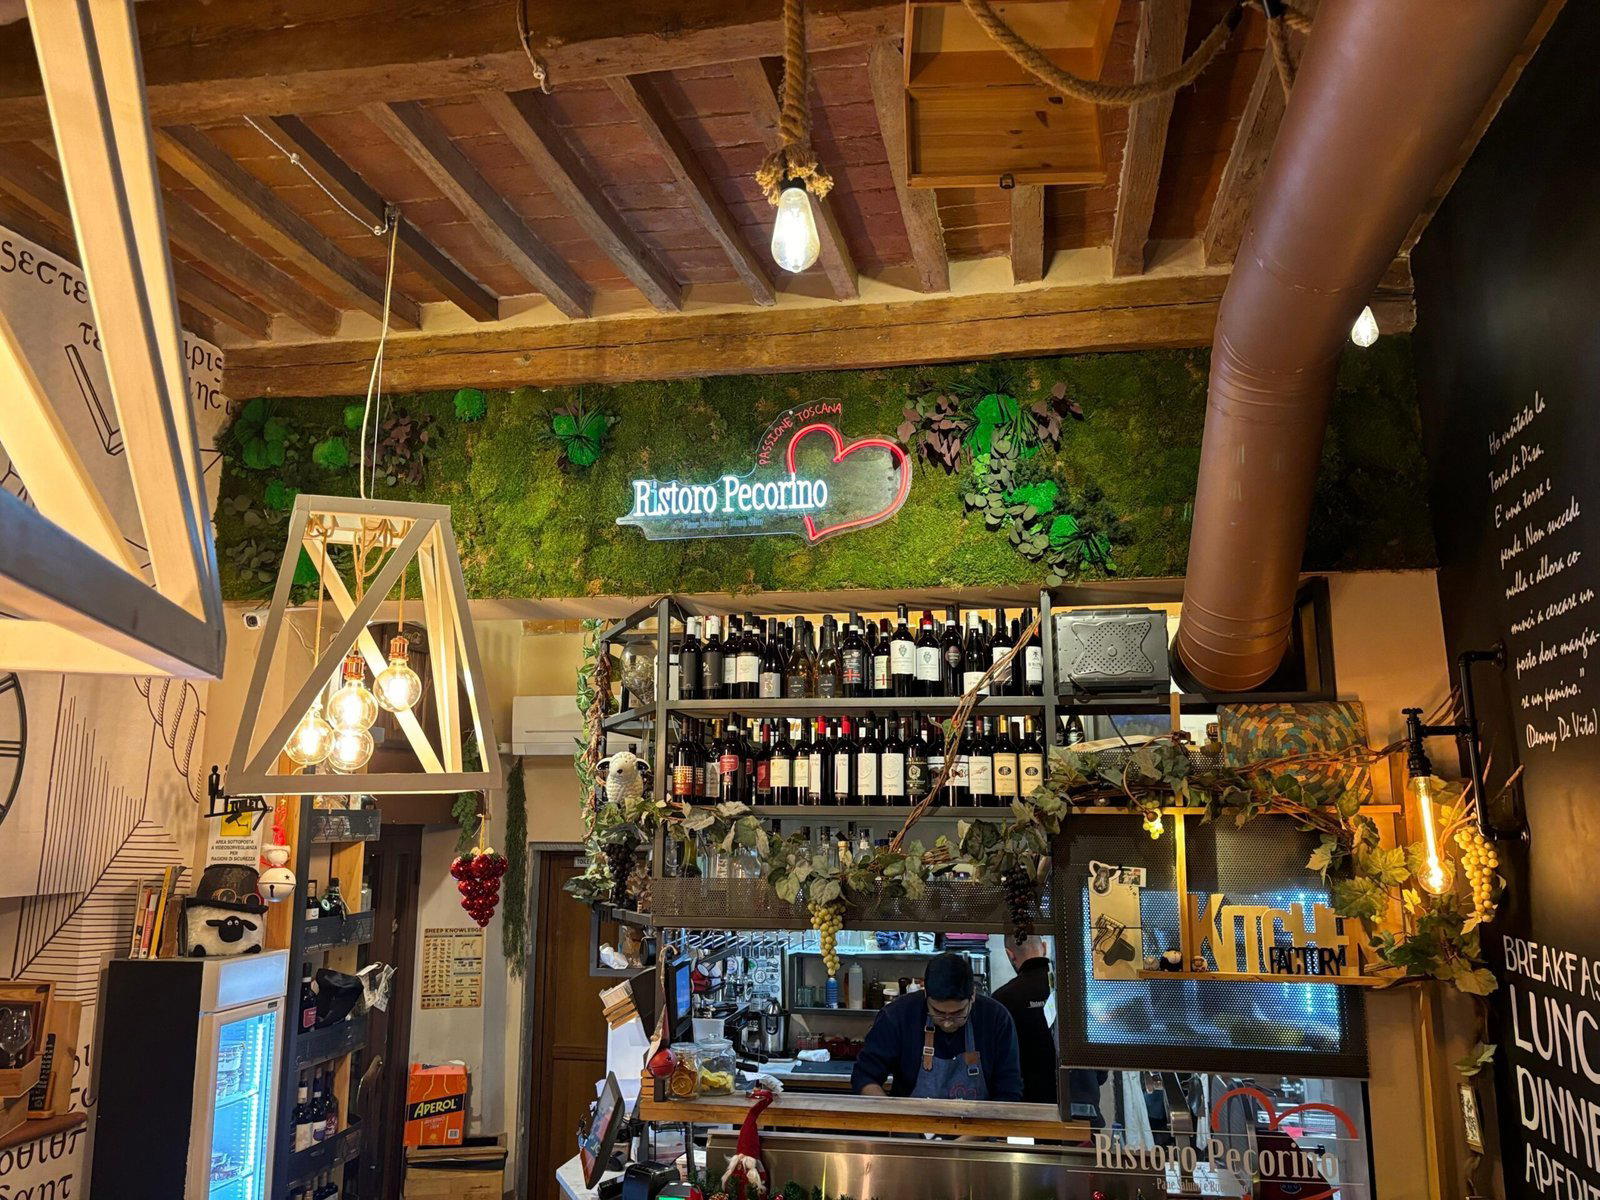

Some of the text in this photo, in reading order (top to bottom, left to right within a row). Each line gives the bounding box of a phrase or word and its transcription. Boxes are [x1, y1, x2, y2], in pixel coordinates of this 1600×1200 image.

[758, 402, 842, 465] PASSIONE TOSCANA
[632, 476, 828, 517] Ristoro Pecorino
[1525, 522, 1545, 549] Non
[1270, 946, 1347, 976] FACTORY
[414, 1098, 457, 1118] APEROL
[1094, 1133, 1338, 1179] Ristoro Pecorino
